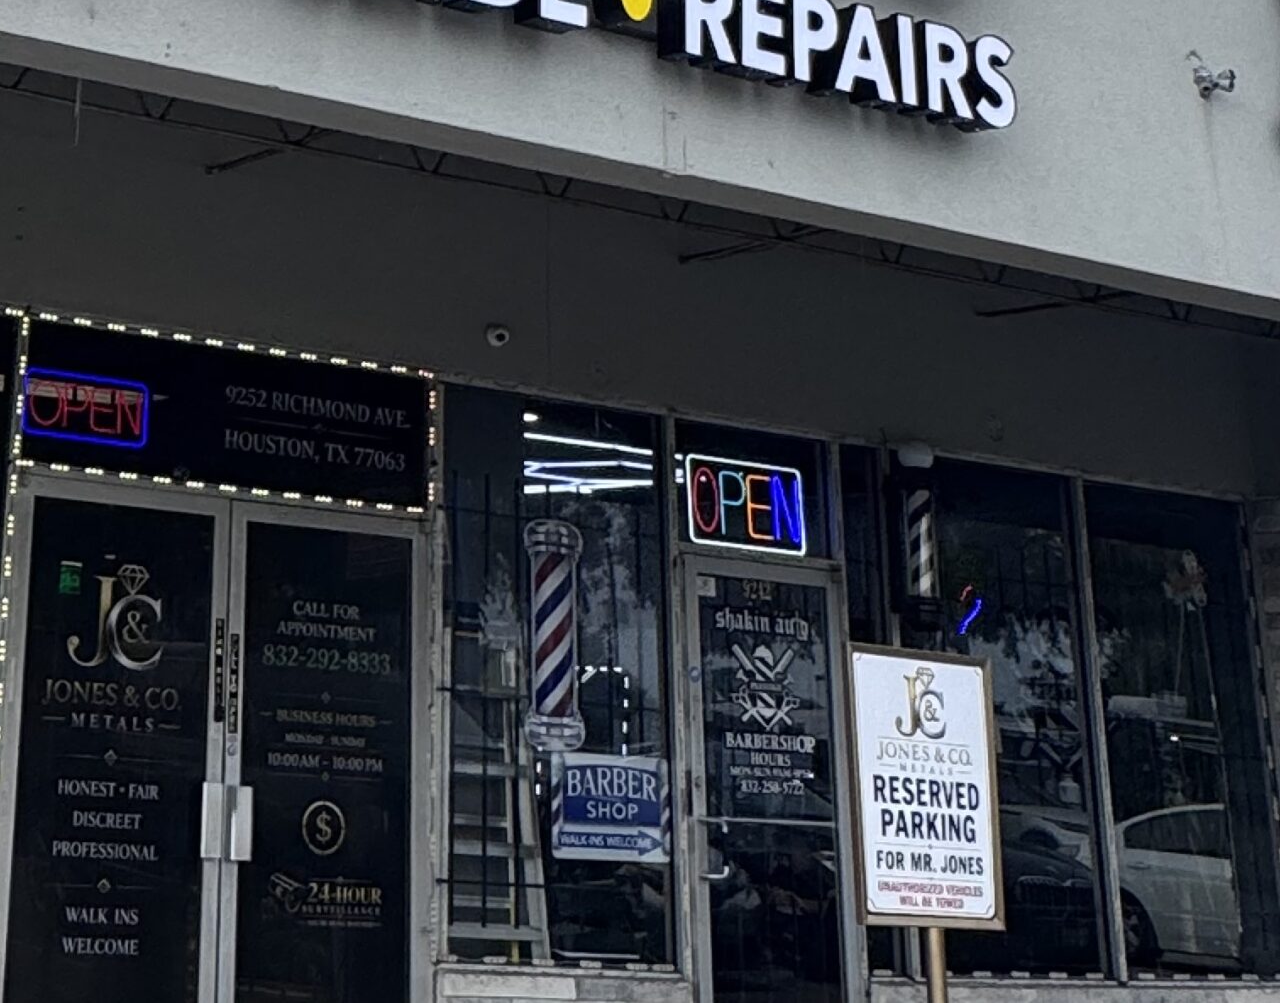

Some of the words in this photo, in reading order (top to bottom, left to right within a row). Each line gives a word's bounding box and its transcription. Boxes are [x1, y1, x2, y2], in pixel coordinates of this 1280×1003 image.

[29, 380, 144, 435] OPEN
[225, 385, 267, 408] 9252
[271, 391, 370, 423] RICHMOND
[224, 429, 320, 463] HOUSTON,
[324, 442, 349, 464] TX
[354, 447, 406, 472] 77063
[693, 467, 801, 543] OPEN
[292, 600, 330, 618] CALL
[333, 603, 360, 620] FOR
[277, 620, 376, 642] APPOINTMENT
[41, 678, 118, 706] JONES
[125, 685, 140, 708] &
[72, 712, 154, 732] METALS
[276, 708, 333, 724] BUSINESS
[725, 732, 816, 753] BARBERSHOP
[876, 742, 930, 761] JONES
[751, 751, 791, 766] HOURS
[900, 764, 953, 776] METALS
[57, 778, 117, 797] HONEST
[128, 783, 159, 800] FAIR
[567, 766, 657, 802] BARBER
[873, 774, 979, 810] RESERVED
[72, 810, 143, 830] DISCREET
[586, 801, 639, 820] SHOP
[881, 809, 976, 844] PARKING
[52, 840, 159, 861] PROFESSIONAL
[876, 850, 905, 871] FOR
[910, 852, 937, 873] MR.
[940, 855, 983, 876] JONES
[65, 906, 108, 925] WALK
[114, 908, 139, 926] INS
[62, 936, 140, 956] WELCOME
